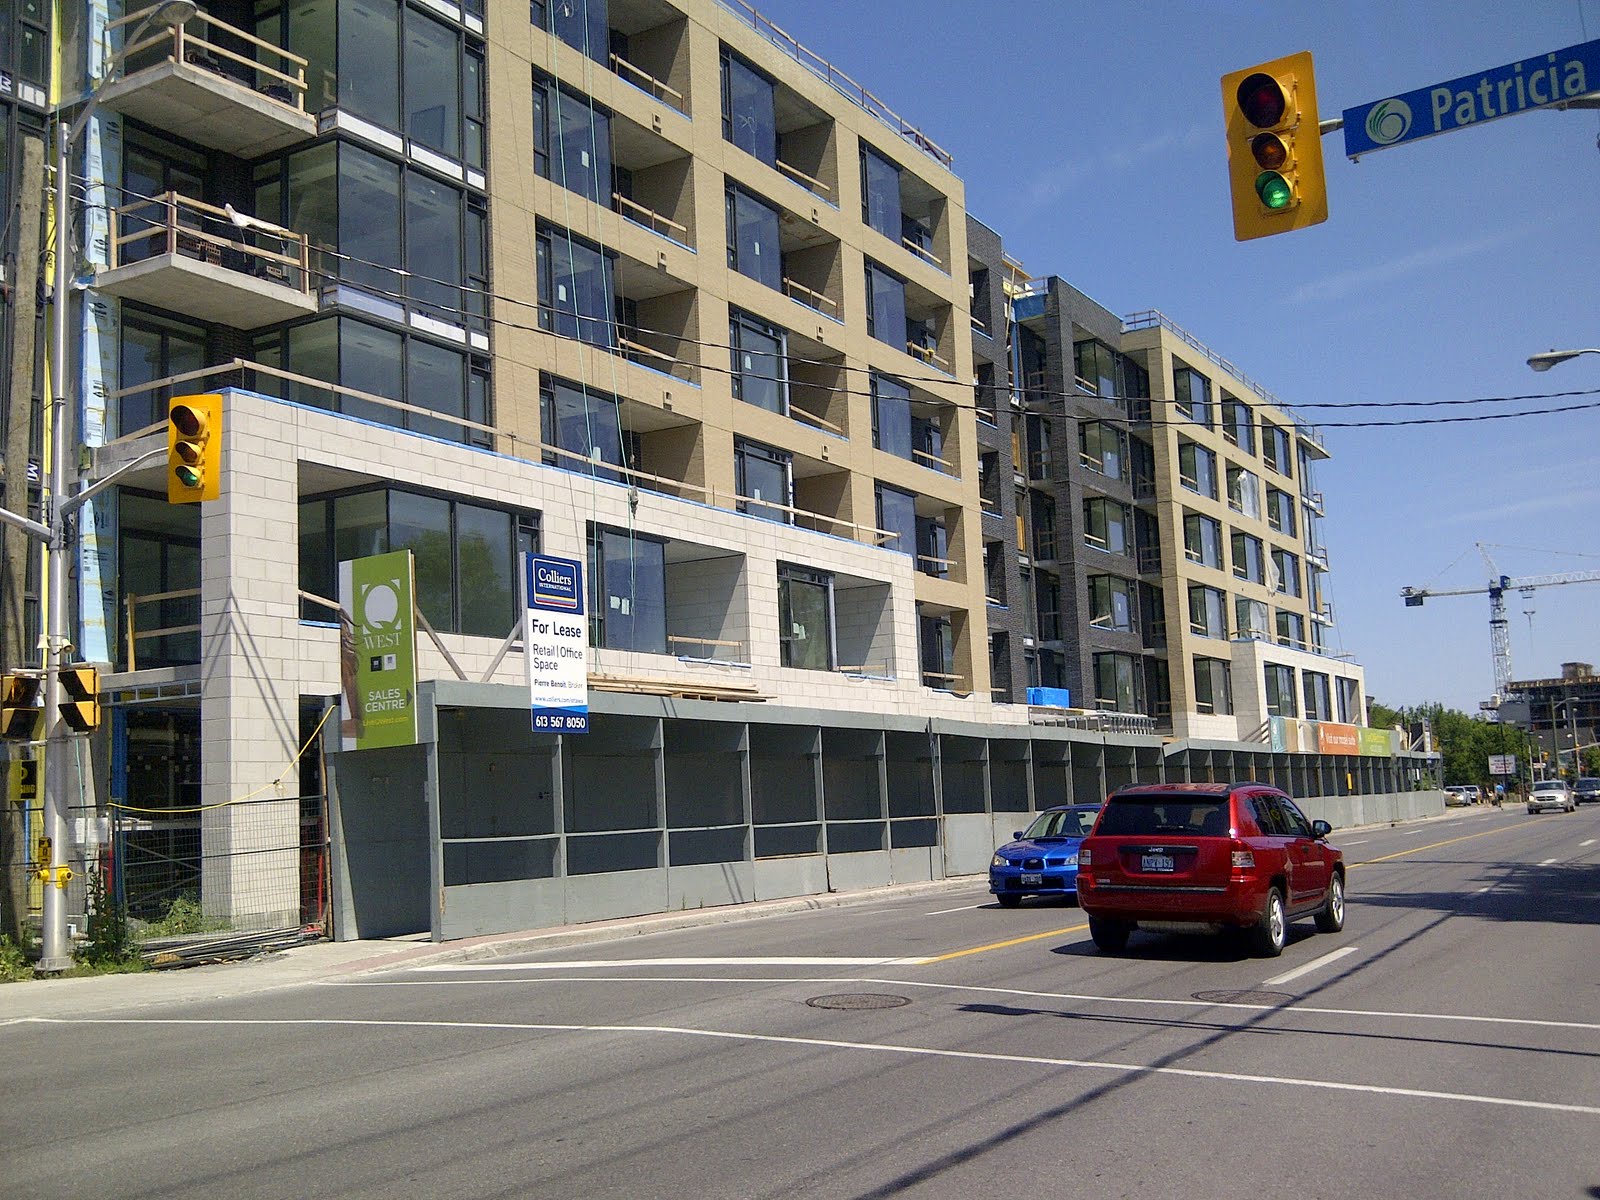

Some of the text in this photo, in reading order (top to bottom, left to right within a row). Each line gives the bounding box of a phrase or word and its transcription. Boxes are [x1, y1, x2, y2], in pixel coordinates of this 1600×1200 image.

[1430, 53, 1587, 131] Patricia
[538, 567, 572, 586] Colliers
[532, 618, 582, 638] For Lease
[363, 631, 401, 650] WEST
[533, 657, 558, 672] Space
[534, 678, 550, 687] Pierre
[368, 688, 401, 701] SALES
[365, 699, 405, 712] CENTRE
[535, 715, 586, 729] 613 567 8050
